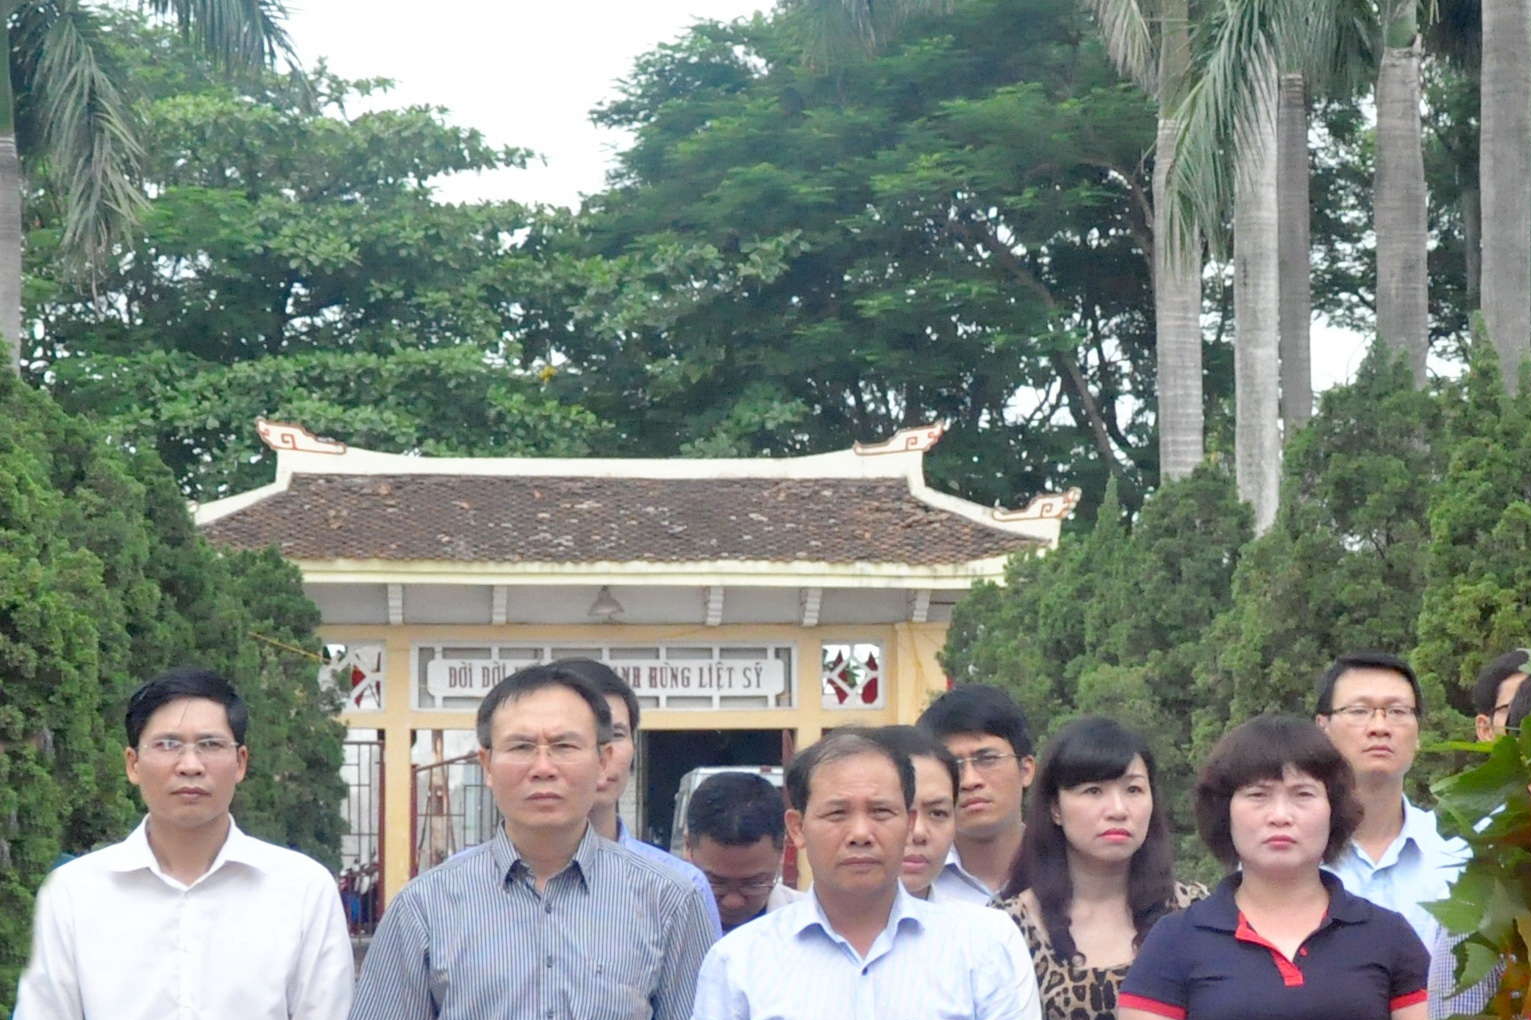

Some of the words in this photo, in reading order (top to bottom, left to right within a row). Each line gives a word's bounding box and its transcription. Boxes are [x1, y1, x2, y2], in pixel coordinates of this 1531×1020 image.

[613, 666, 641, 688] NH
[649, 662, 691, 689] HÙNG
[698, 661, 735, 691] LIỆT
